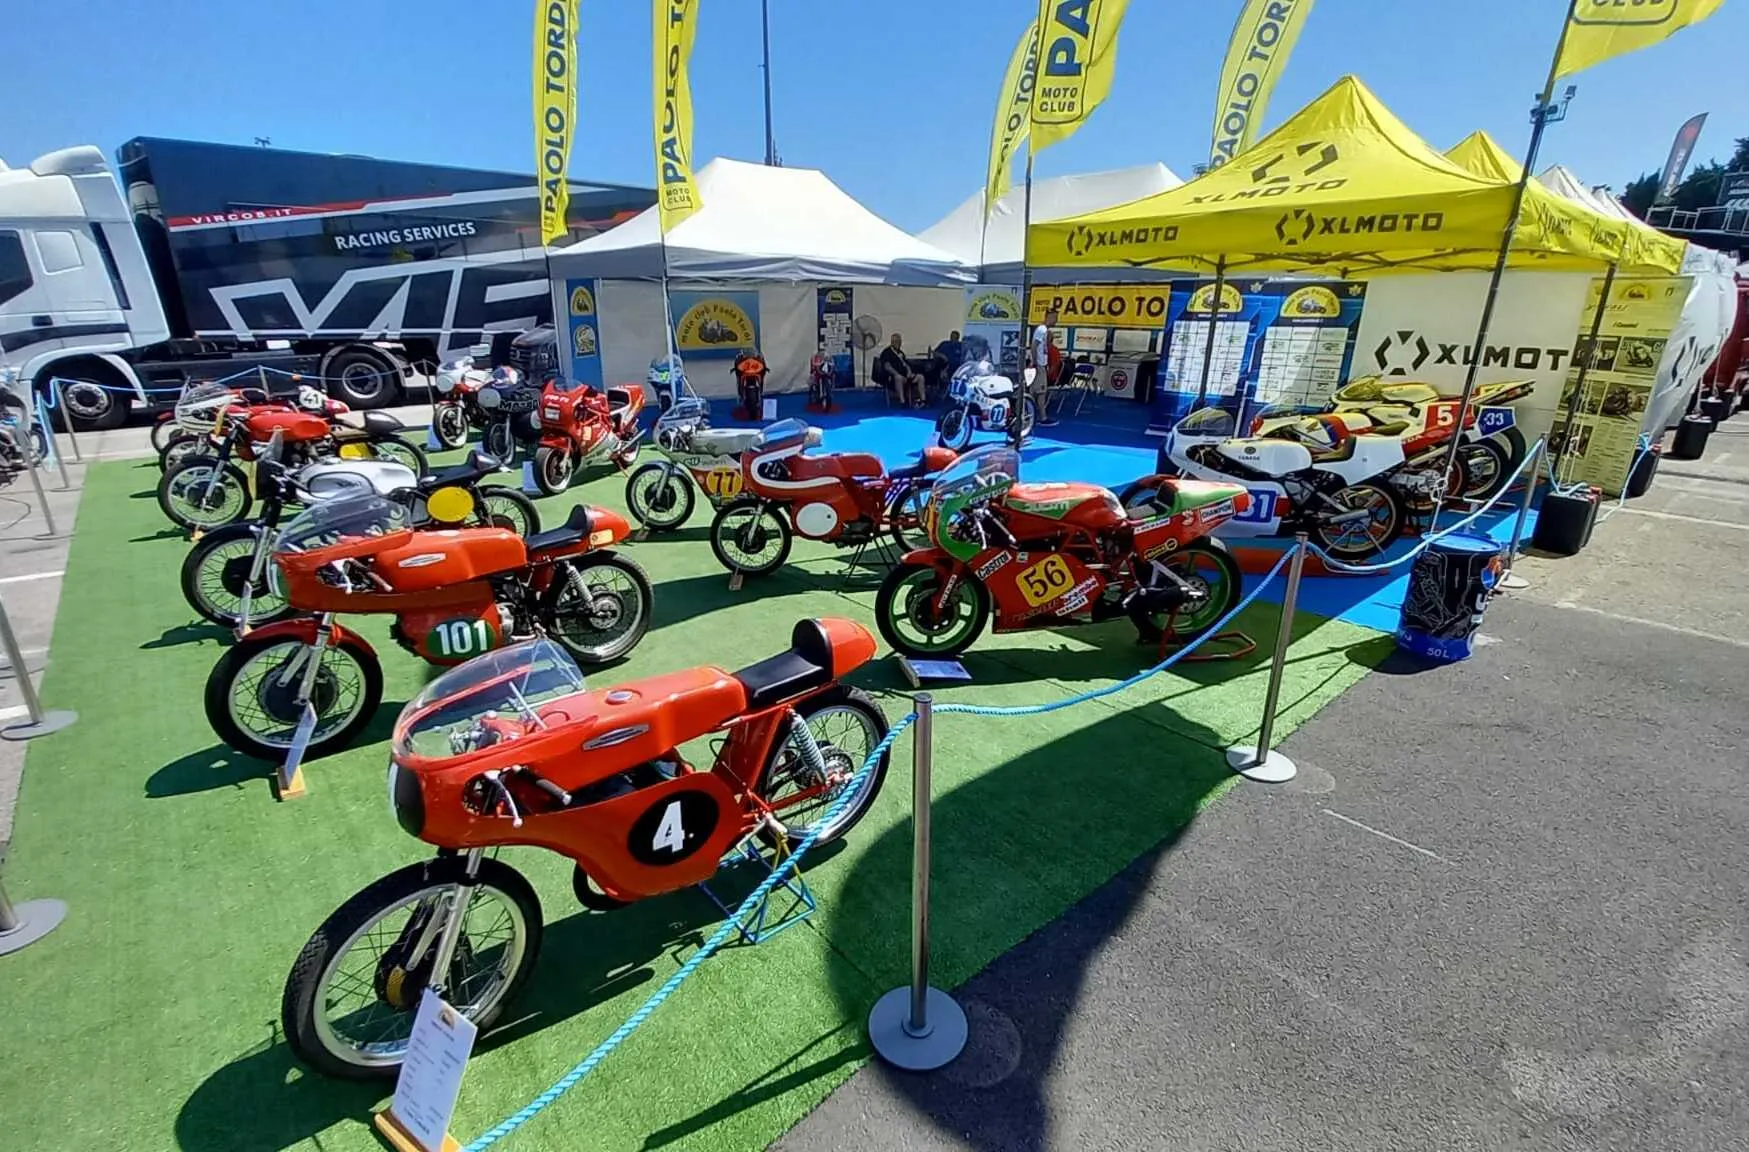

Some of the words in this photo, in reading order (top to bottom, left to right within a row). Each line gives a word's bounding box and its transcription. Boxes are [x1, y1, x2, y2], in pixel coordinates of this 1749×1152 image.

[1040, 86, 1079, 99] MOTO
[1039, 100, 1076, 113] CLUB
[1185, 178, 1349, 205] XLMOTO
[1318, 211, 1444, 235] XLMOTO
[334, 229, 401, 250] RACING
[403, 221, 477, 243] SERVICES
[1095, 225, 1180, 247] XLMOTO
[1053, 296, 1127, 317] PAOLO
[1135, 296, 1165, 317] TO
[1437, 405, 1454, 426] 5
[713, 471, 736, 494] 77
[1023, 560, 1066, 598] 56
[435, 619, 488, 656] 101
[652, 800, 686, 854] 4
